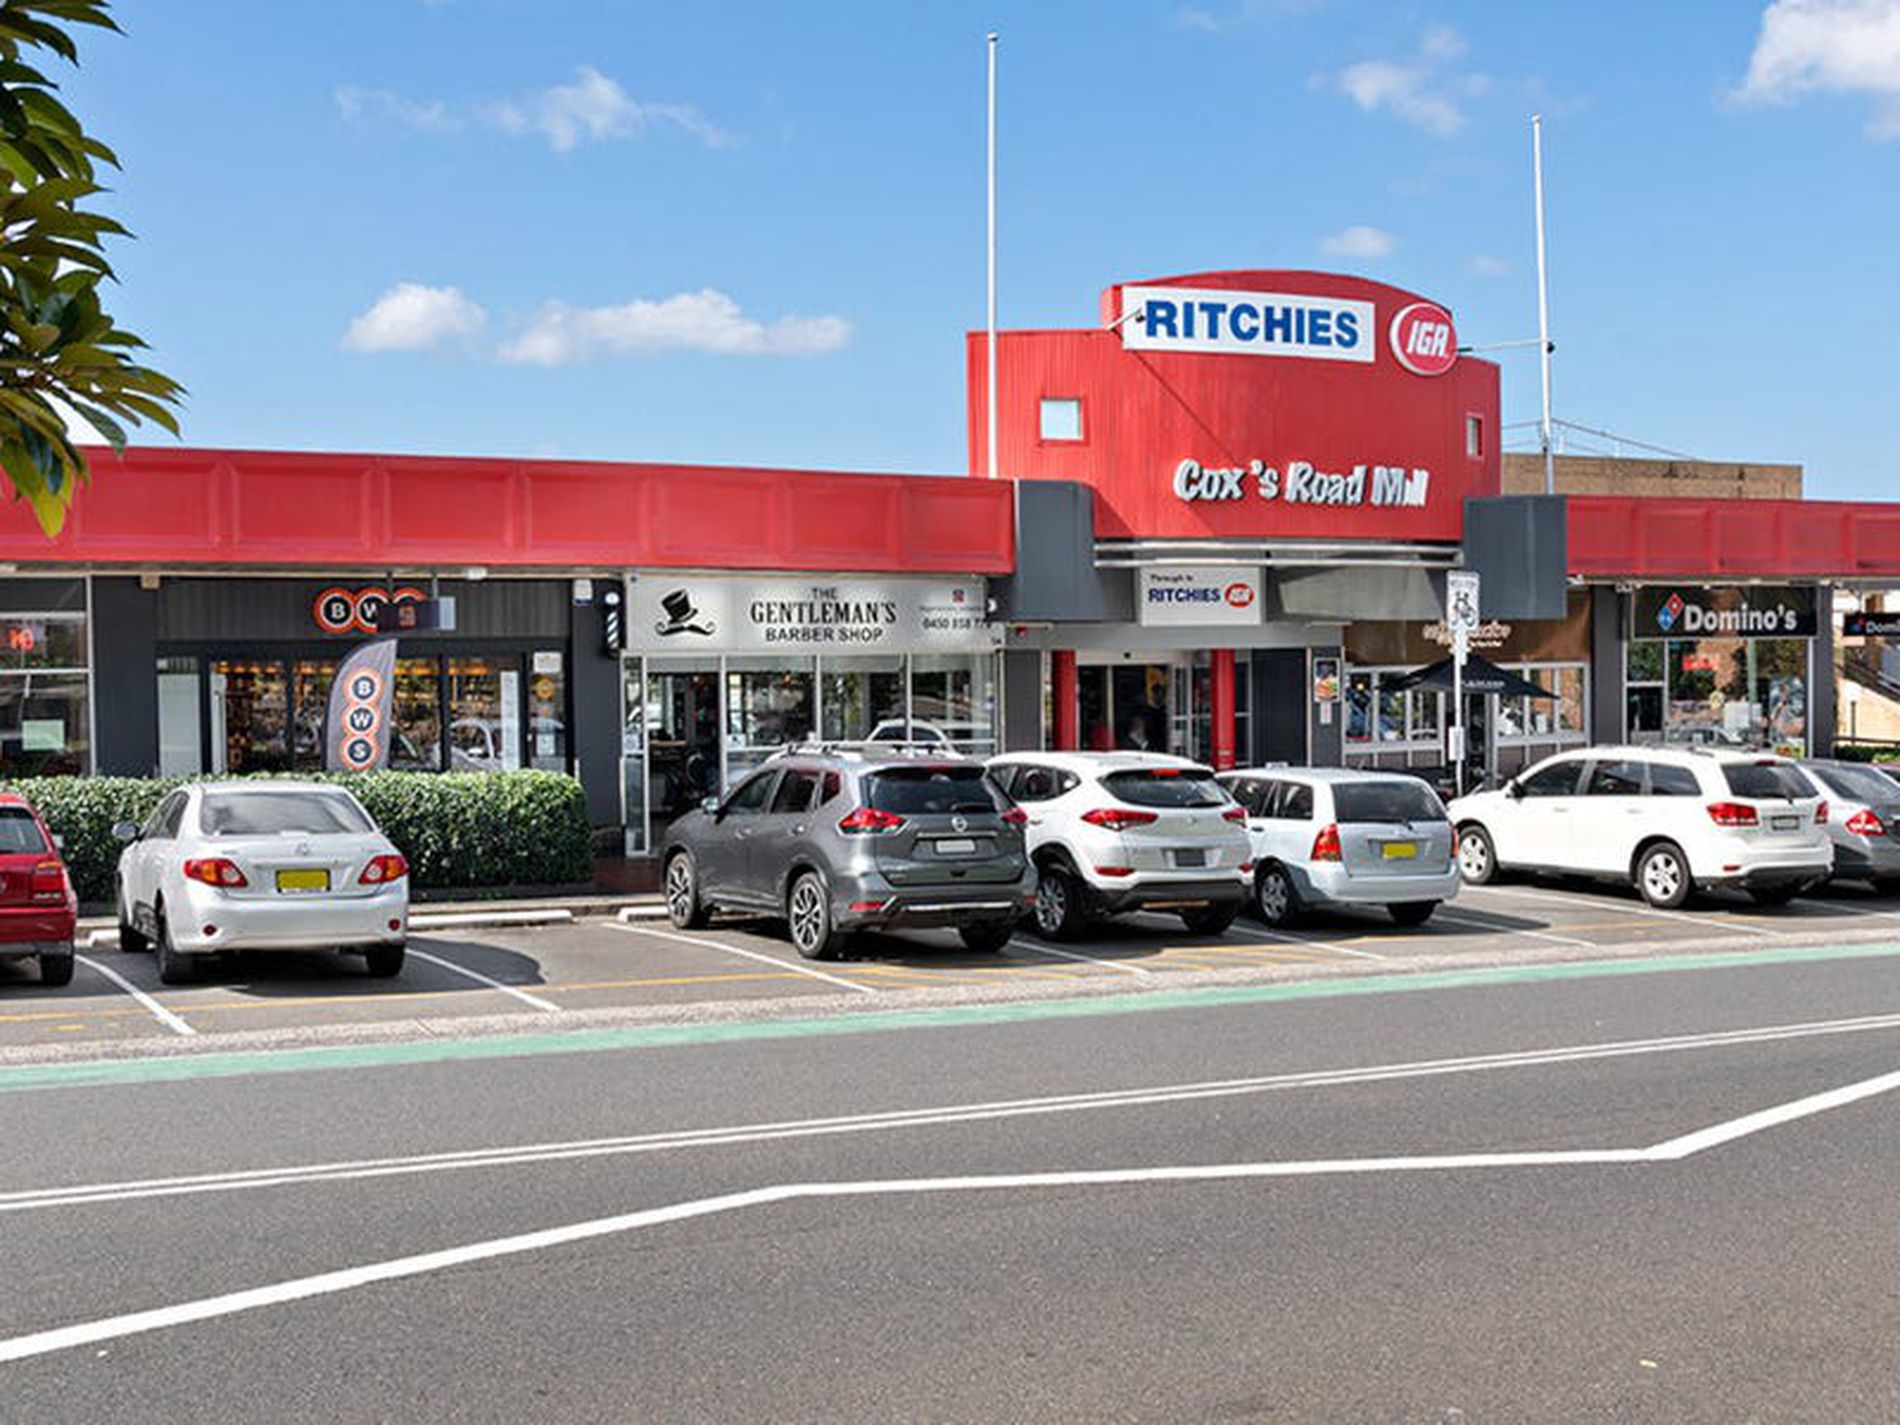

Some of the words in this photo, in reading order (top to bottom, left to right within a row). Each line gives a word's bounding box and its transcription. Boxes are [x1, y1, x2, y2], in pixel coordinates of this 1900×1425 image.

[1145, 300, 1360, 349] RITCHIES
[1406, 319, 1450, 358] IGA
[1285, 461, 1367, 505] Road
[811, 587, 838, 600] THE
[1148, 587, 1221, 603] RITCHIES
[750, 601, 897, 625] GENTLEMAN'S
[1684, 602, 1797, 631] Domino's
[765, 626, 835, 643] BARBER
[838, 627, 883, 643] SHOP
